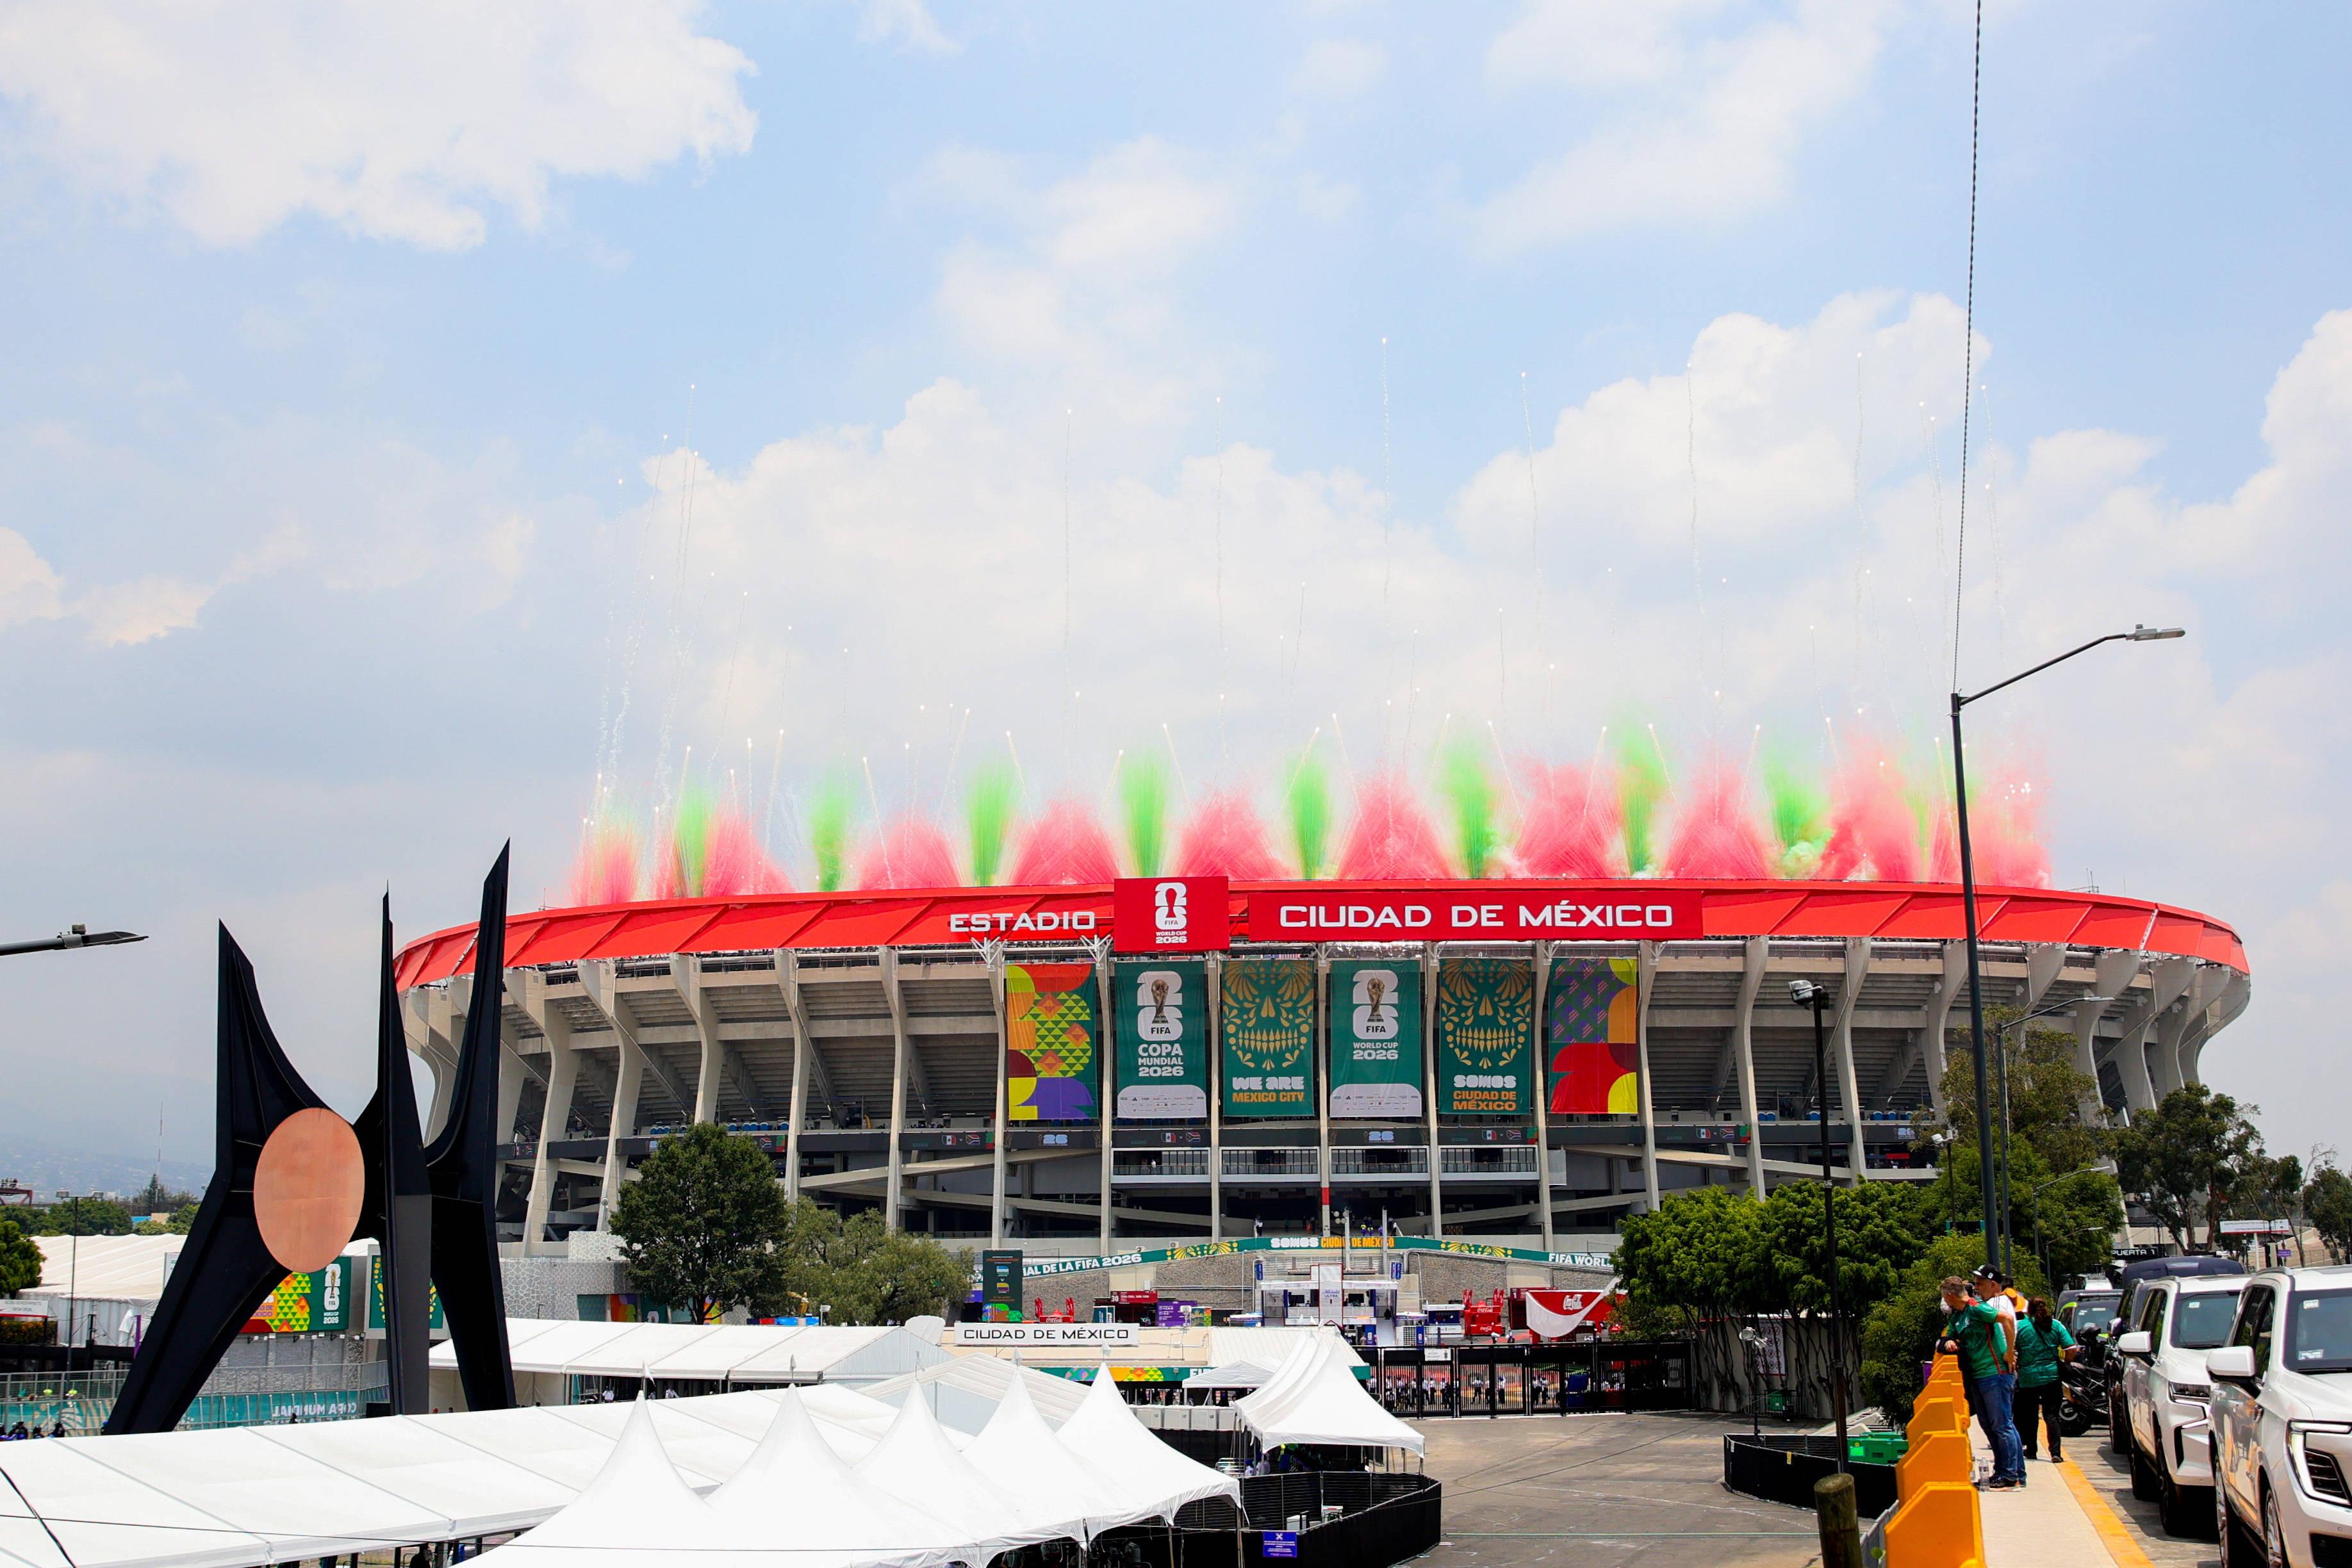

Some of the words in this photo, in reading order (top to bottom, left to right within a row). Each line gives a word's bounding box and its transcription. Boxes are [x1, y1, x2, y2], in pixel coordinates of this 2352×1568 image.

[1280, 906, 1432, 927] CIUDAD
[1451, 906, 1504, 927] DE
[1519, 900, 1672, 927] MÉXICO
[950, 911, 1095, 932] ESTADIO
[1138, 1043, 1183, 1056] COPA
[1353, 1050, 1398, 1060] 2026
[1139, 1057, 1183, 1065] MUNDIAL
[1139, 1066, 1184, 1076] 2026
[1232, 1077, 1262, 1090] WE
[1454, 1075, 1517, 1088] SOMOS
[1232, 1092, 1276, 1102] MEXICO
[1279, 1091, 1304, 1102] CITY
[1453, 1091, 1499, 1100] CIUDAD
[1501, 1091, 1517, 1100] DE
[1453, 1099, 1517, 1111] MÉXICO
[1271, 1237, 1319, 1248] SOMOS
[1352, 1237, 1362, 1248] DE
[1042, 1263, 1057, 1273] DE
[1059, 1261, 1074, 1271] LA
[1074, 1258, 1099, 1270] FIFA
[1102, 1254, 1142, 1266] 2026
[1549, 1253, 1573, 1264] FIFA
[964, 1329, 1026, 1339] CIUDAD
[1034, 1329, 1056, 1339] DE
[1062, 1327, 1129, 1339] MÉXICO
